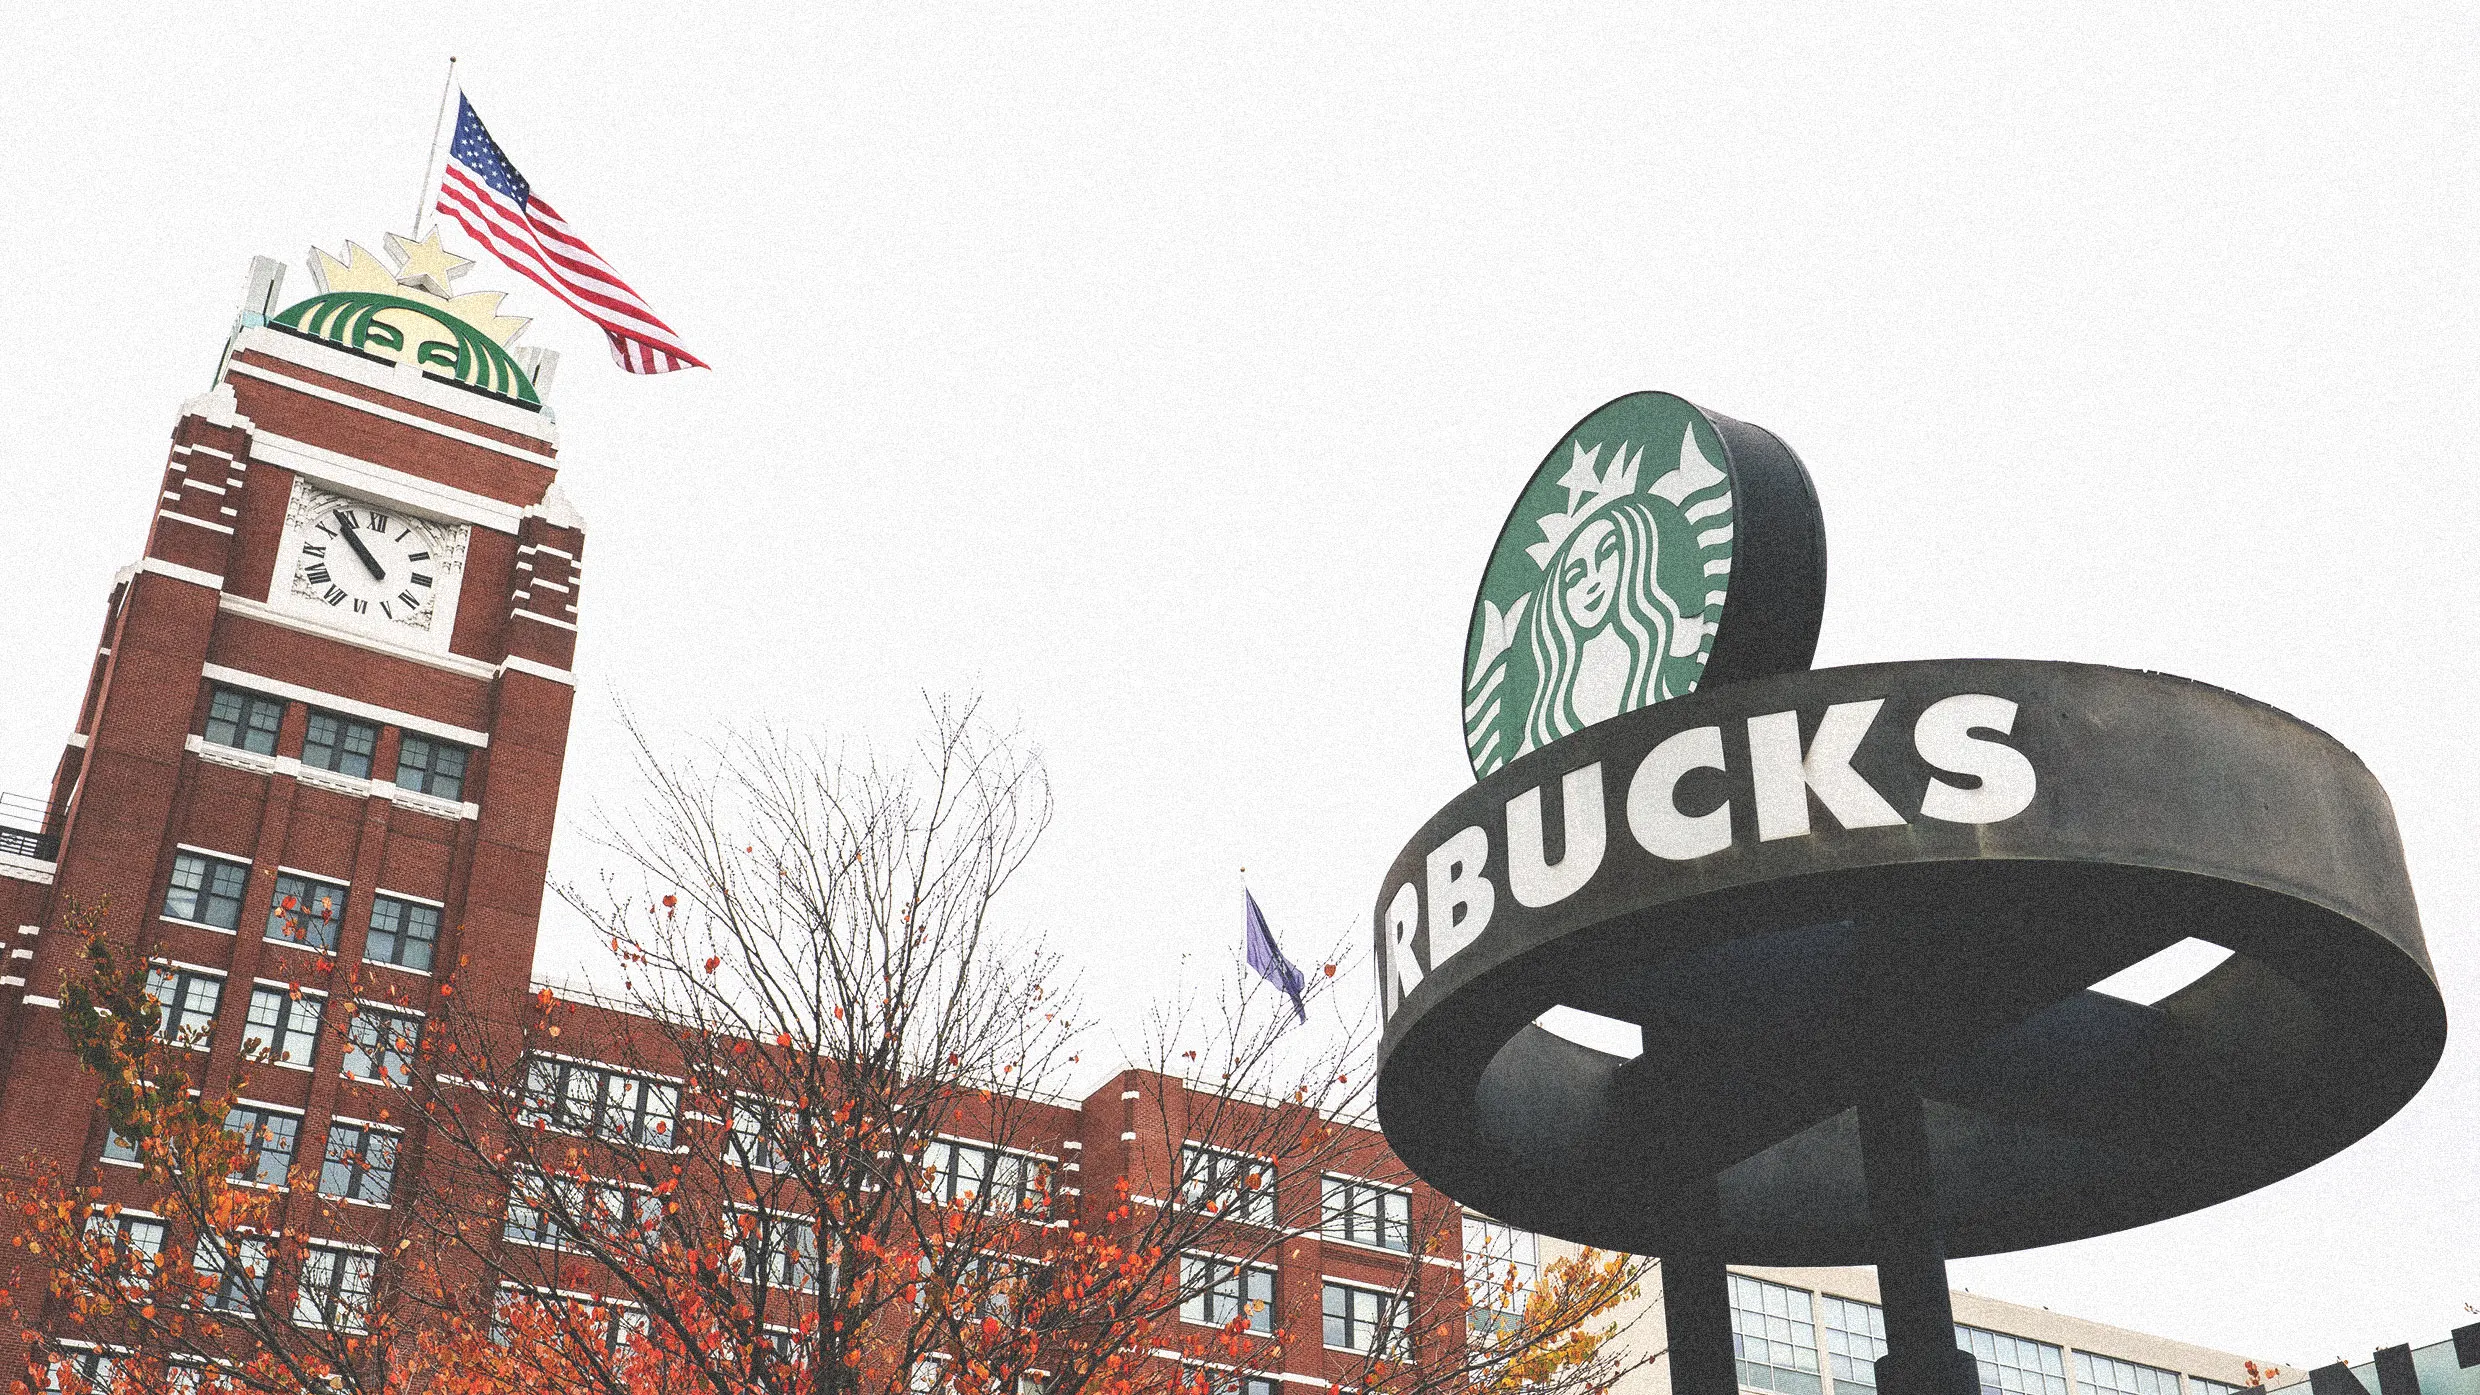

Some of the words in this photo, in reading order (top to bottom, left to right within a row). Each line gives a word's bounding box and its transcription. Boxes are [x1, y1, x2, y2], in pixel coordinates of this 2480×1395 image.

[315, 520, 338, 540] X
[366, 511, 389, 534] XII
[394, 527, 411, 543] I
[302, 541, 326, 558] IX
[408, 551, 430, 562] II
[304, 562, 331, 584] VIII
[410, 572, 433, 588] III
[323, 583, 348, 606] VII
[398, 589, 420, 610] IV
[354, 598, 368, 614] VI
[379, 600, 392, 619] V
[1384, 694, 2037, 1024] RBUCKS
